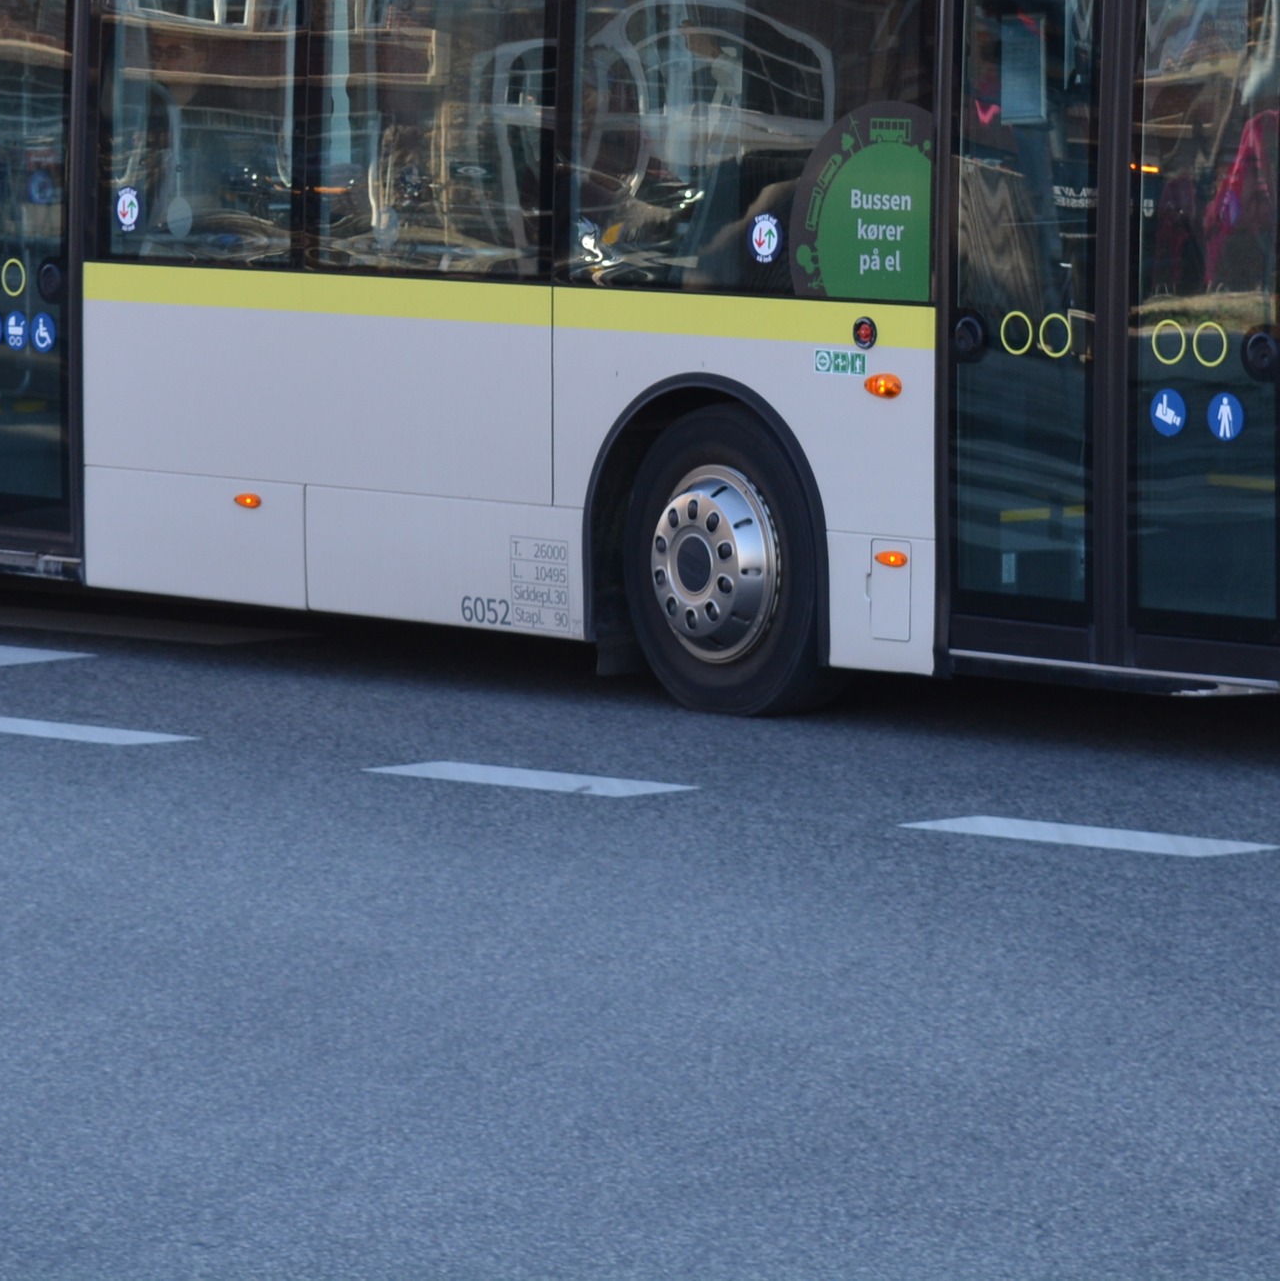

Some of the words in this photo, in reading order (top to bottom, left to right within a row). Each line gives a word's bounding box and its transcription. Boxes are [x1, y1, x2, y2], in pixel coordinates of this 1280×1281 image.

[850, 189, 911, 211] Bussen
[857, 219, 904, 241] kører
[859, 248, 880, 274] på
[885, 250, 901, 272] el
[534, 543, 566, 561] 26000
[535, 566, 567, 583] 10495
[554, 589, 567, 606] 30
[461, 596, 512, 626] 6052
[554, 612, 568, 628] 90
